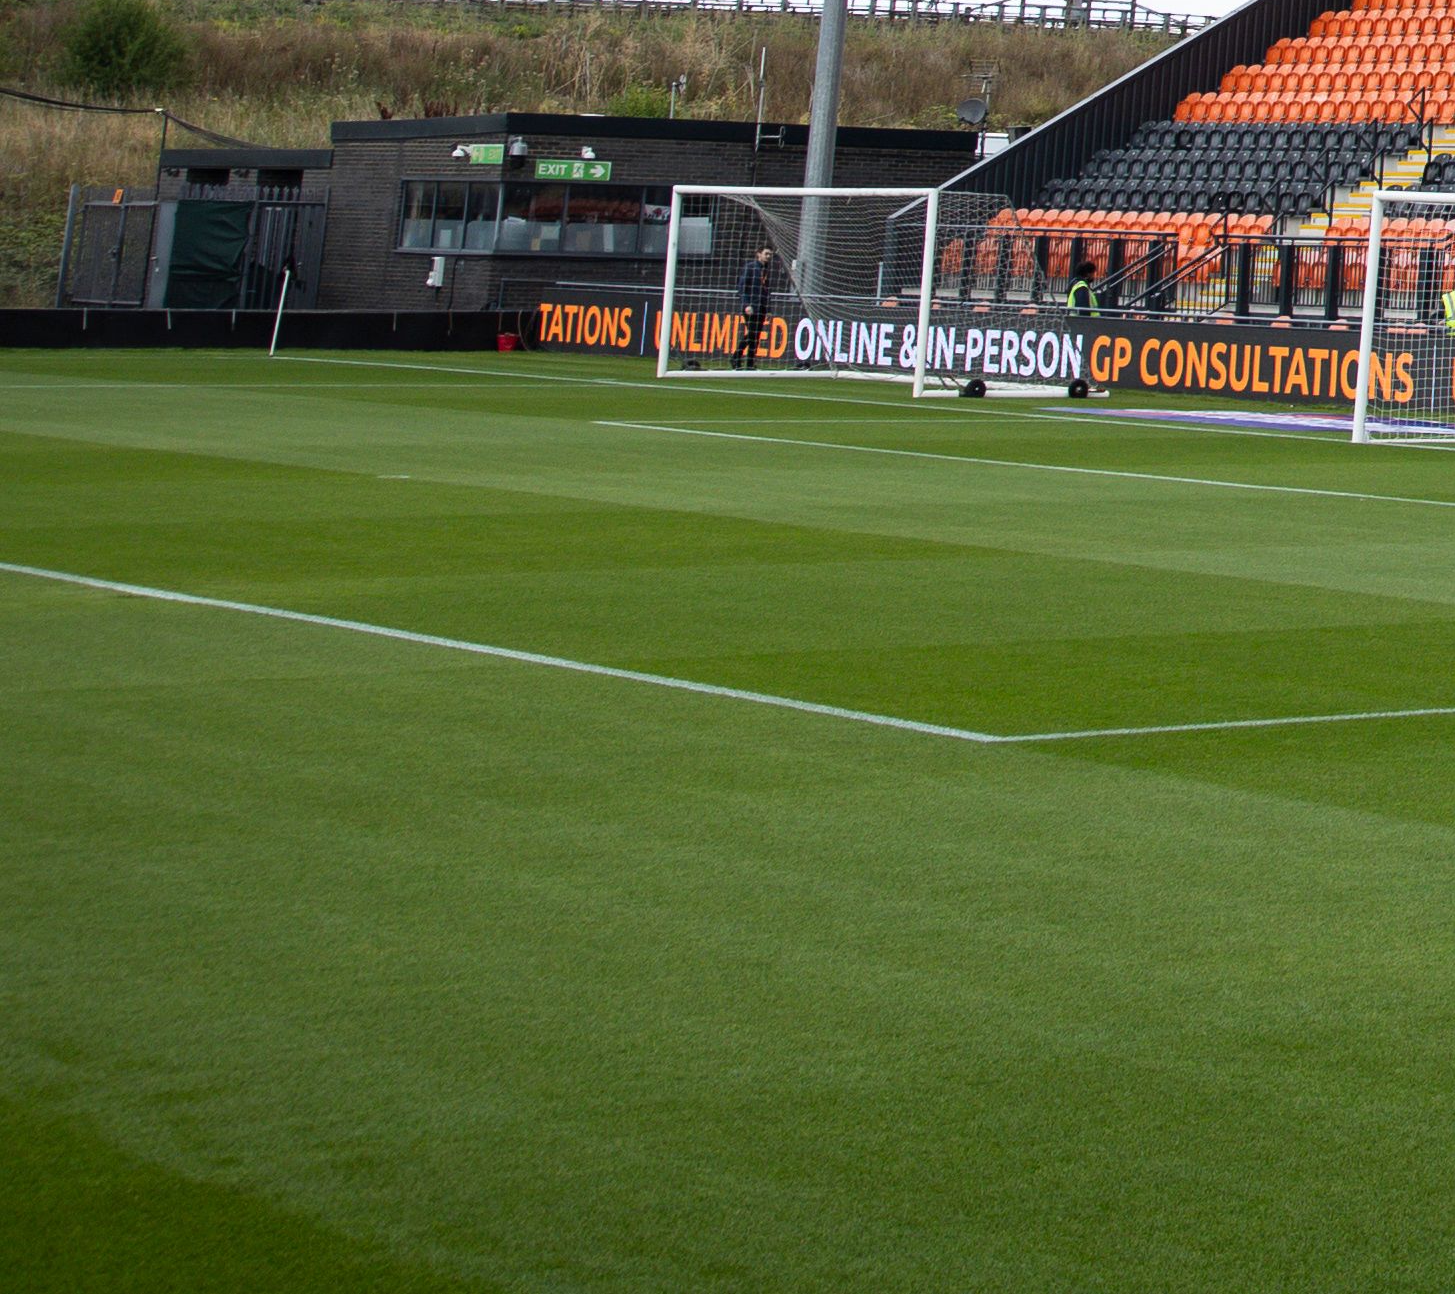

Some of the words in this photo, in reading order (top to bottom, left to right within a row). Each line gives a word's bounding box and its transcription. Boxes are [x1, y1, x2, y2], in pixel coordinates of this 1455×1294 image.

[538, 163, 568, 176] EXIT
[540, 303, 632, 348] TATIONS
[654, 310, 788, 358] NLIMIED
[794, 317, 895, 366] ONLINE
[926, 325, 1083, 379] IN-PERSON
[1090, 335, 1132, 382] GP
[1139, 338, 1414, 403] CONSULTATIONS
